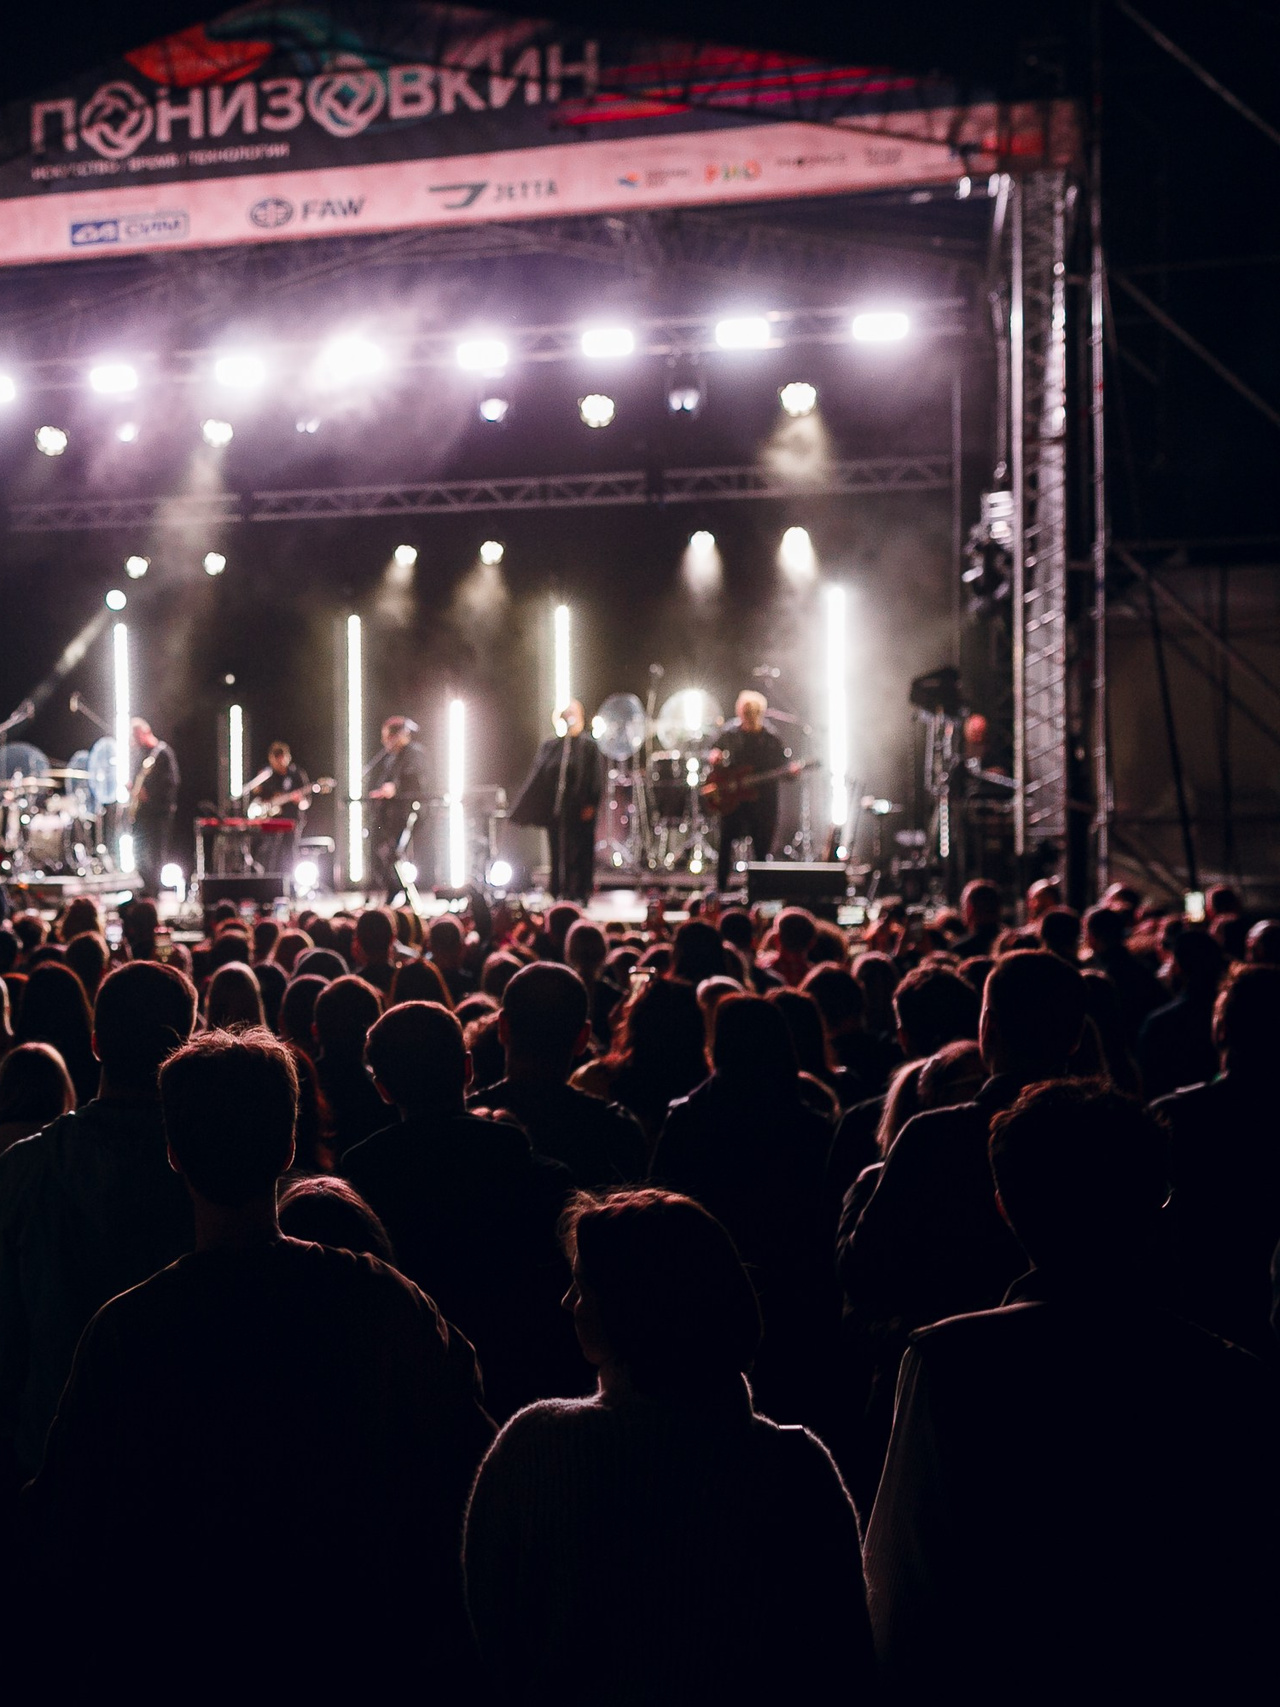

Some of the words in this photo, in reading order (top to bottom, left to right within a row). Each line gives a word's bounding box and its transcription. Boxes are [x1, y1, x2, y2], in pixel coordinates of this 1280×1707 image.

[30, 38, 600, 160] ПОНИЗОВКИН
[493, 179, 558, 204] JETTA
[302, 196, 366, 222] FAW
